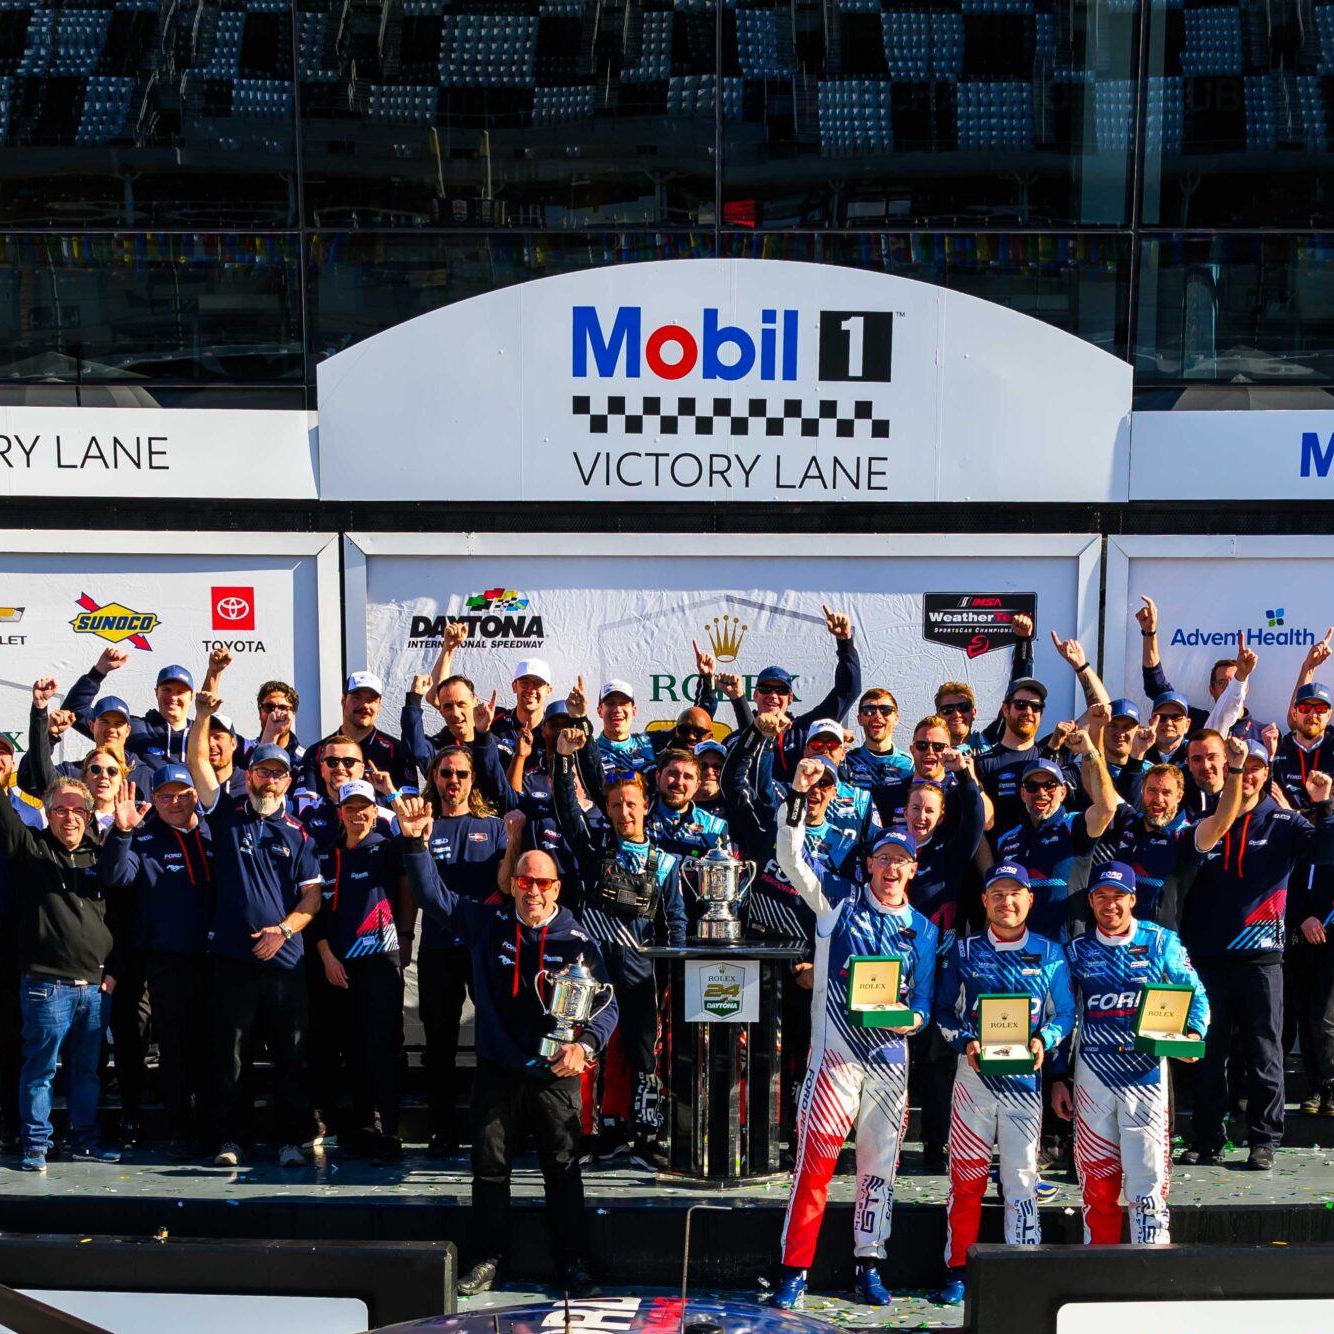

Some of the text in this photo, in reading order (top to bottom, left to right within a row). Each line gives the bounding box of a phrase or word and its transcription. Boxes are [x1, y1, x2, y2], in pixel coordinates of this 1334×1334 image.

[572, 305, 866, 381] Mobil 1
[56, 436, 170, 470] LANE
[573, 451, 889, 491] VICTORY LANE
[76, 613, 156, 632] SUNOCO
[929, 612, 1014, 622] WeatherTe
[491, 640, 544, 649] SPEEDWAY
[995, 866, 1018, 874] FORD
[1101, 871, 1123, 879] FORD
[704, 984, 740, 997] 24
[1087, 991, 1142, 1010] FOR
[1148, 1010, 1175, 1018] ROLEX
